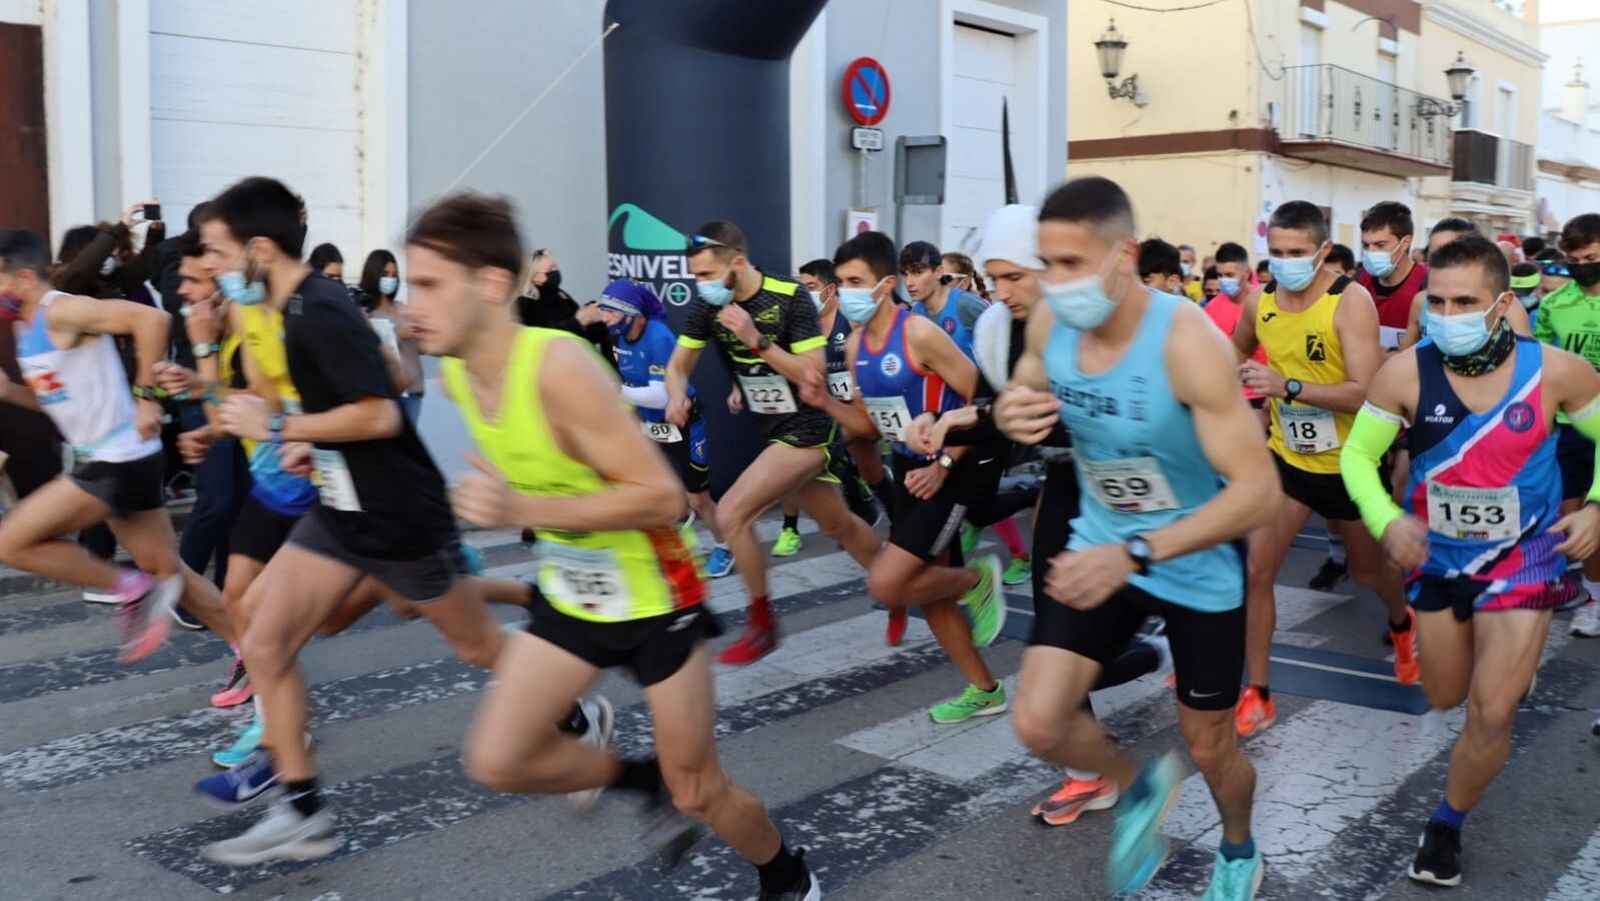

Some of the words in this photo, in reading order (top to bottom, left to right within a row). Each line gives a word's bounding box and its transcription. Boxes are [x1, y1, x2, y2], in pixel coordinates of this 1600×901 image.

[1565, 332, 1589, 354] IV
[748, 388, 785, 403] 222
[1288, 420, 1317, 439] 18
[1425, 415, 1454, 424] VIATOR
[1101, 477, 1151, 498] 69
[1438, 502, 1506, 525] 153
